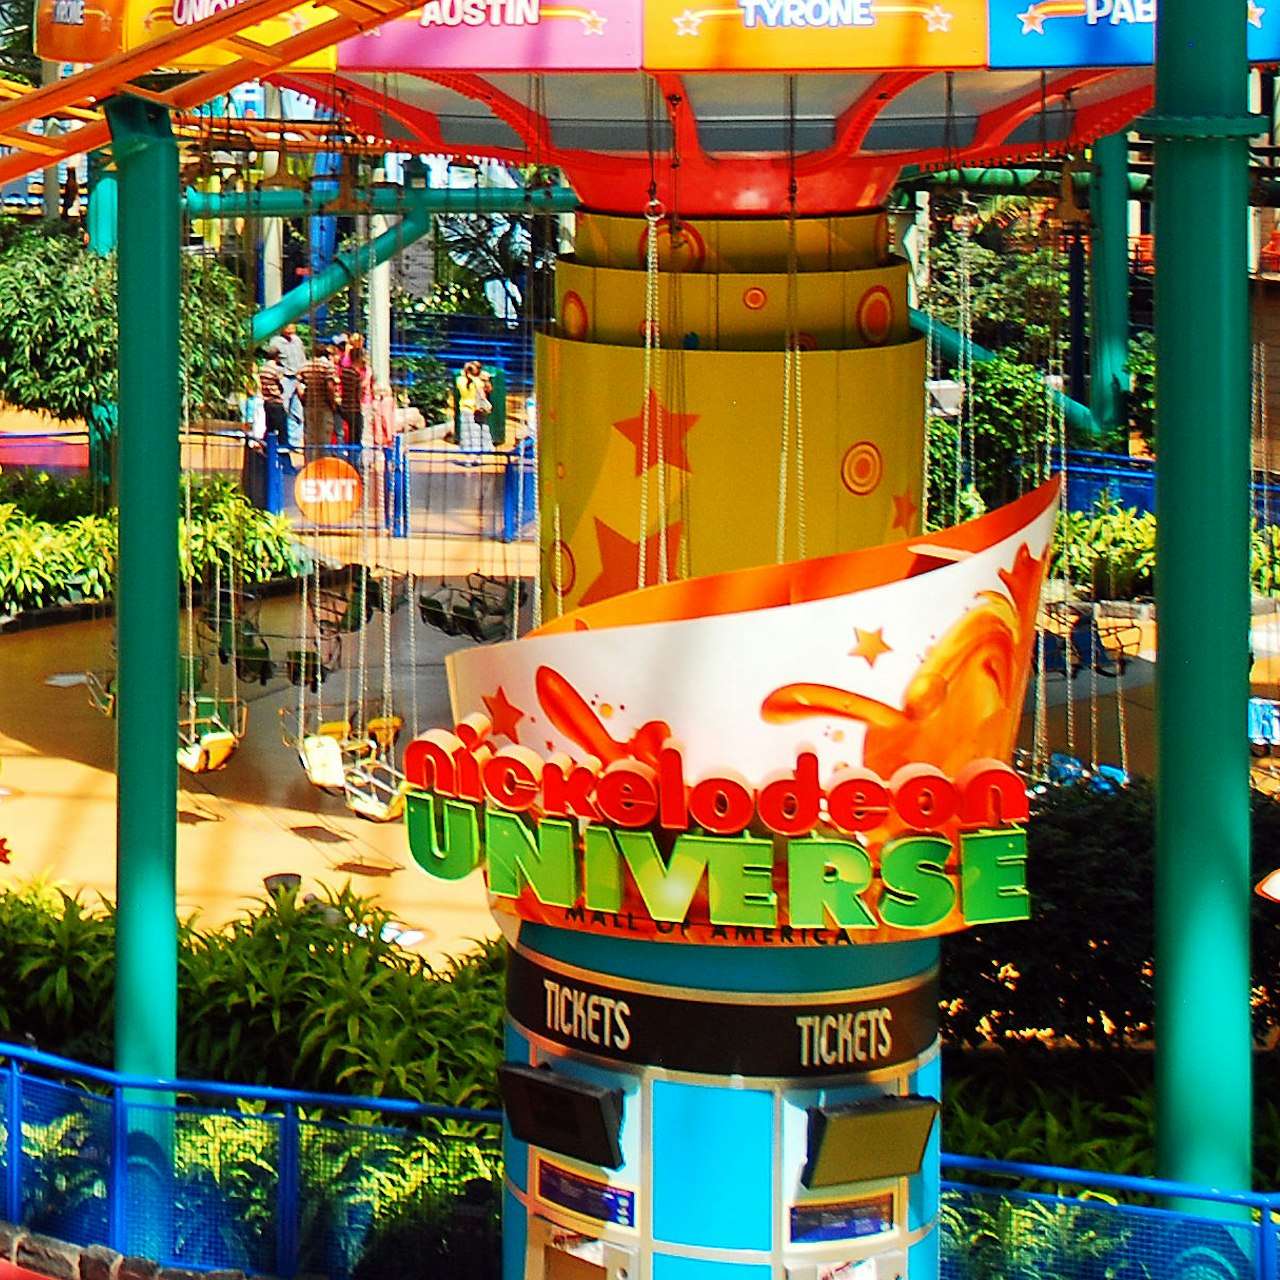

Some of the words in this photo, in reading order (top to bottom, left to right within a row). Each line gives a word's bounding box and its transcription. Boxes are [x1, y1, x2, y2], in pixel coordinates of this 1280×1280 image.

[301, 478, 358, 503] EXIT
[402, 712, 1031, 837] nickelodeon
[404, 790, 1032, 930] UNIVERSE
[544, 979, 632, 1051] TICKETS
[796, 1007, 893, 1067] TICKETS
